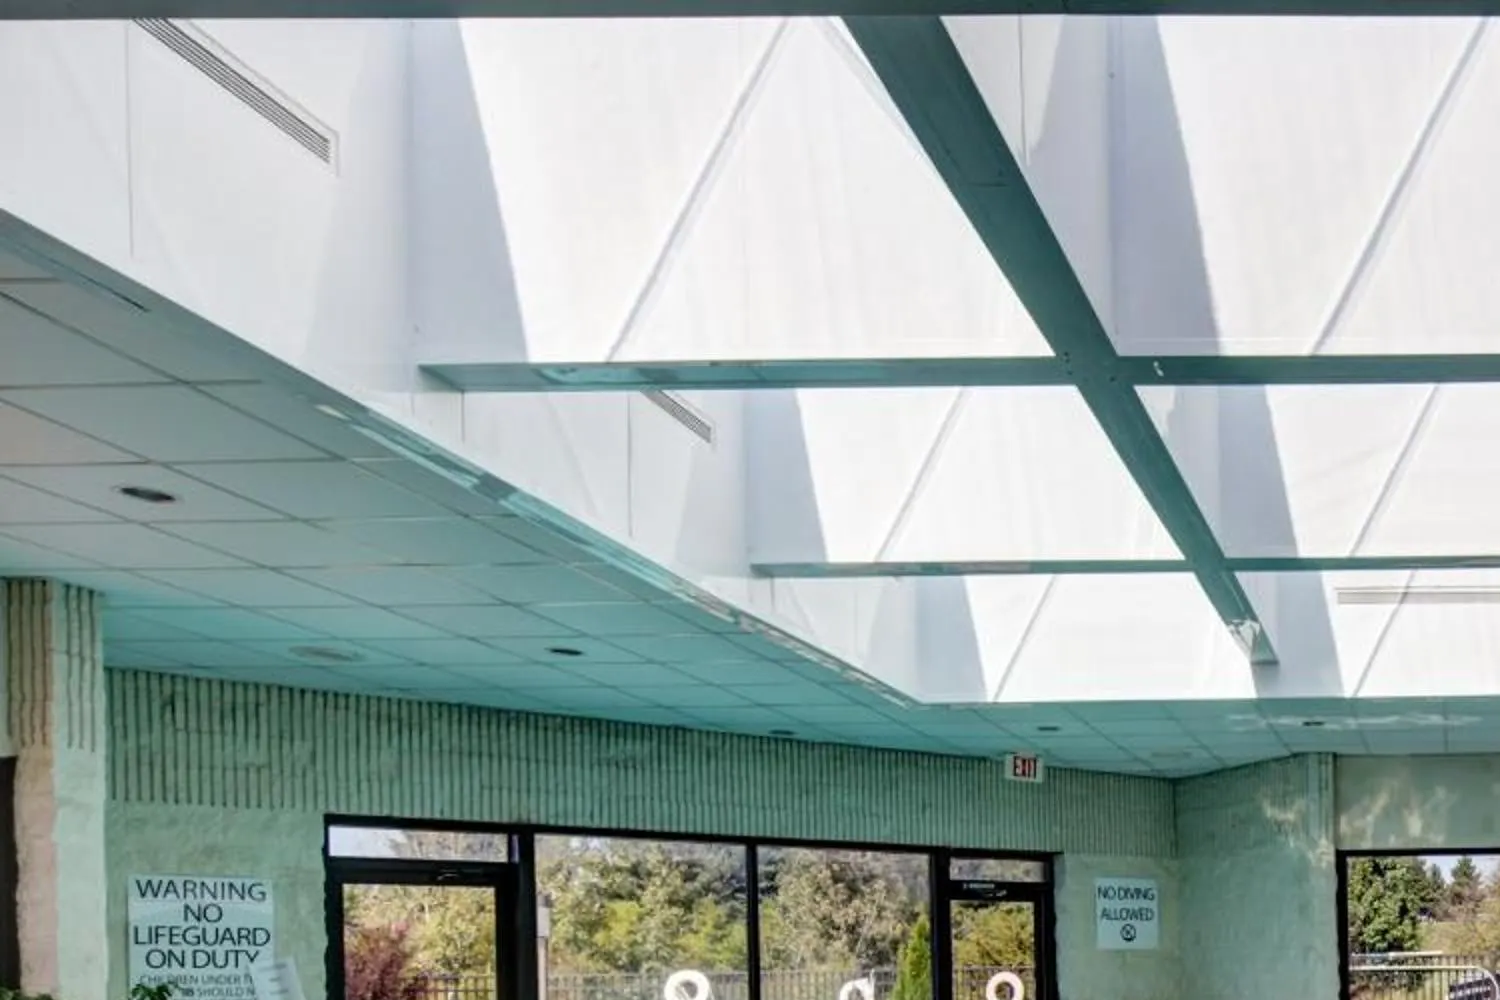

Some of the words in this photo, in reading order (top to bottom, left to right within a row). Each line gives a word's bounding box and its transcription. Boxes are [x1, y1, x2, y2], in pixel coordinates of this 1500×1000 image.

[136, 879, 267, 902] WARNING
[1097, 886, 1117, 900] NO
[183, 903, 223, 923] NO
[1101, 907, 1155, 921] ALLOWED
[134, 926, 271, 946] LIFEGUARD
[145, 949, 185, 969] ON
[192, 950, 260, 969] DUTY
